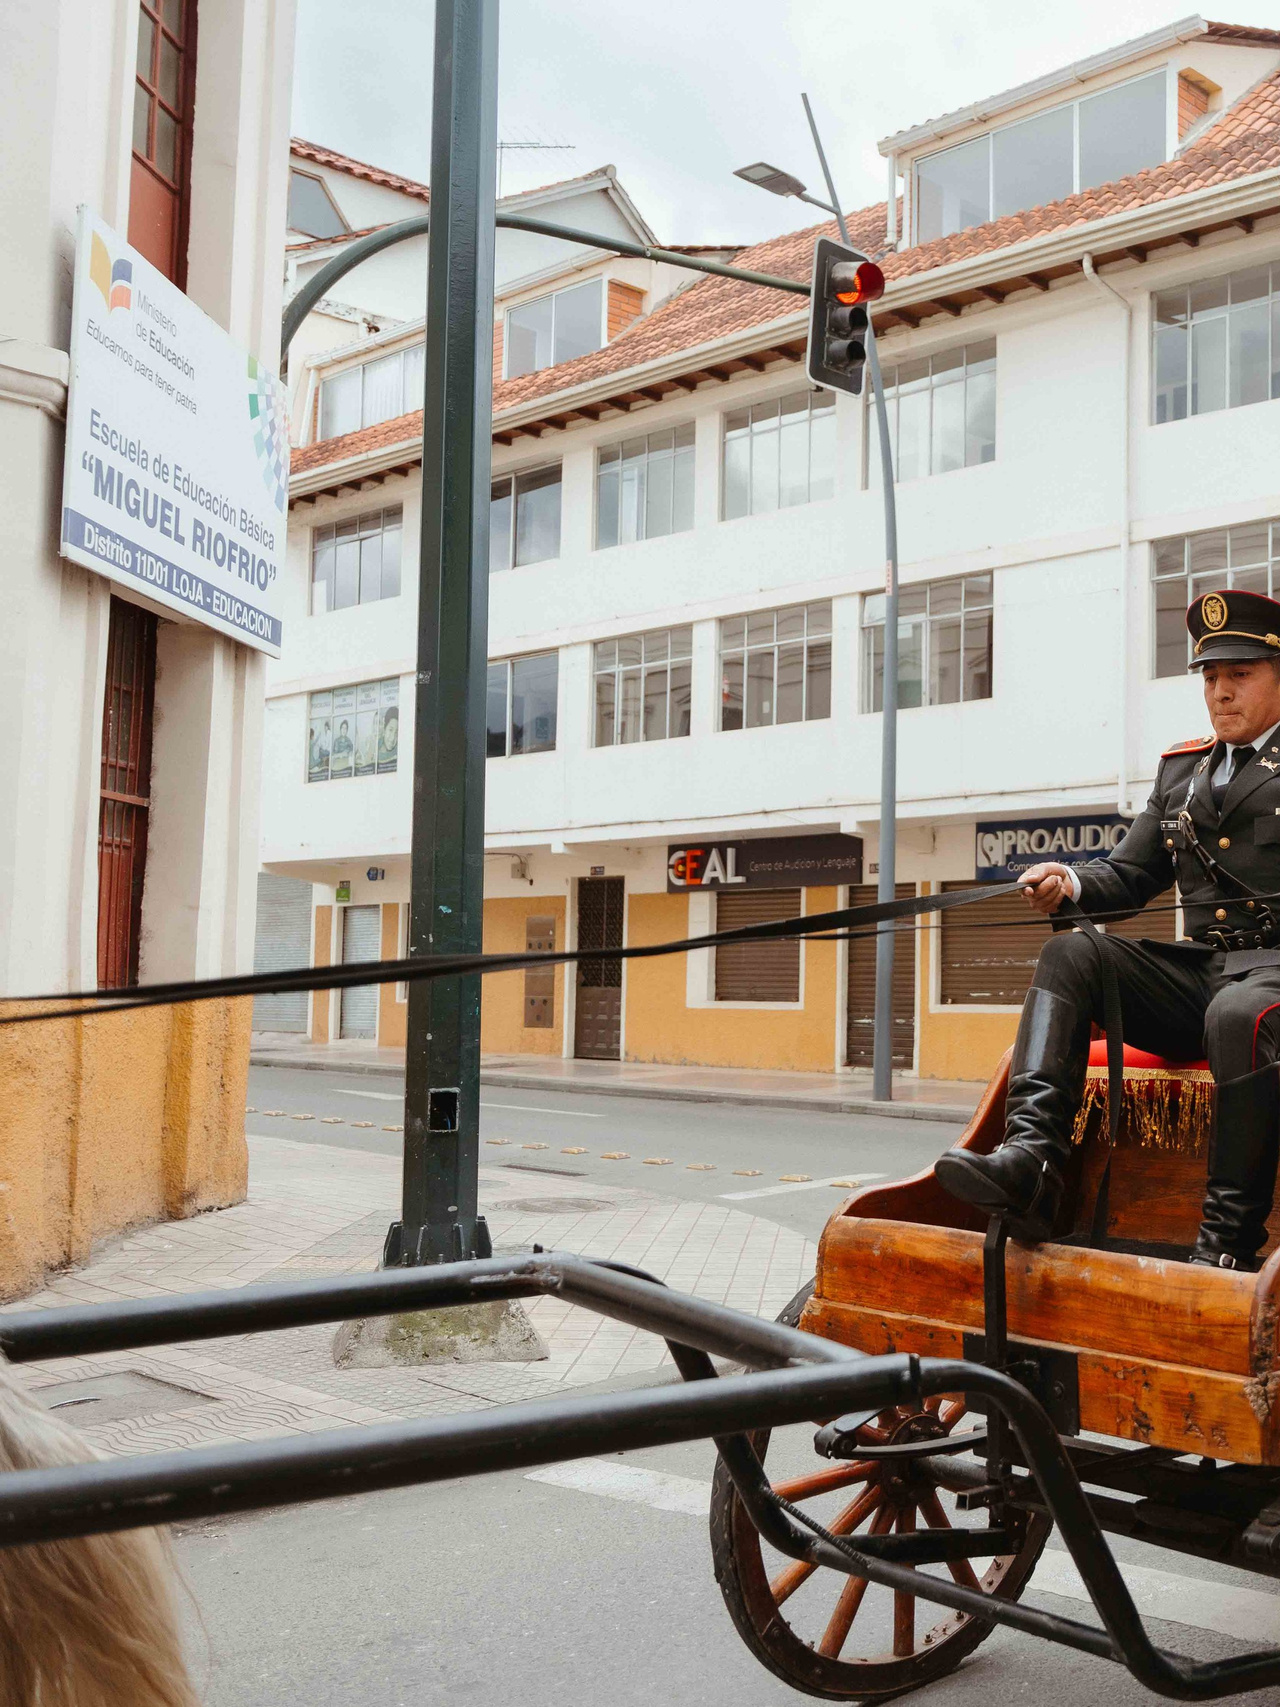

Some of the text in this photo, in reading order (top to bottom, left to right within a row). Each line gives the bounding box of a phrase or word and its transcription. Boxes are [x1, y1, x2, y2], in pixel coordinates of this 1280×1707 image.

[137, 289, 178, 338] Ministerio
[86, 318, 198, 415] Educamos para tener patria
[136, 321, 195, 381] de Educación
[90, 408, 275, 552] Escuela de Educación Básica
[84, 522, 132, 569] Distrito
[135, 551, 169, 588] 11D01
[172, 569, 204, 607] LOJA
[212, 592, 272, 639] EDUCACION
[749, 860, 773, 872] Centro
[773, 860, 783, 871] de
[816, 860, 822, 870] y
[823, 855, 857, 870] Lenguaje
[1003, 824, 1131, 855] PROAUDIO
[668, 847, 747, 887] CEAL
